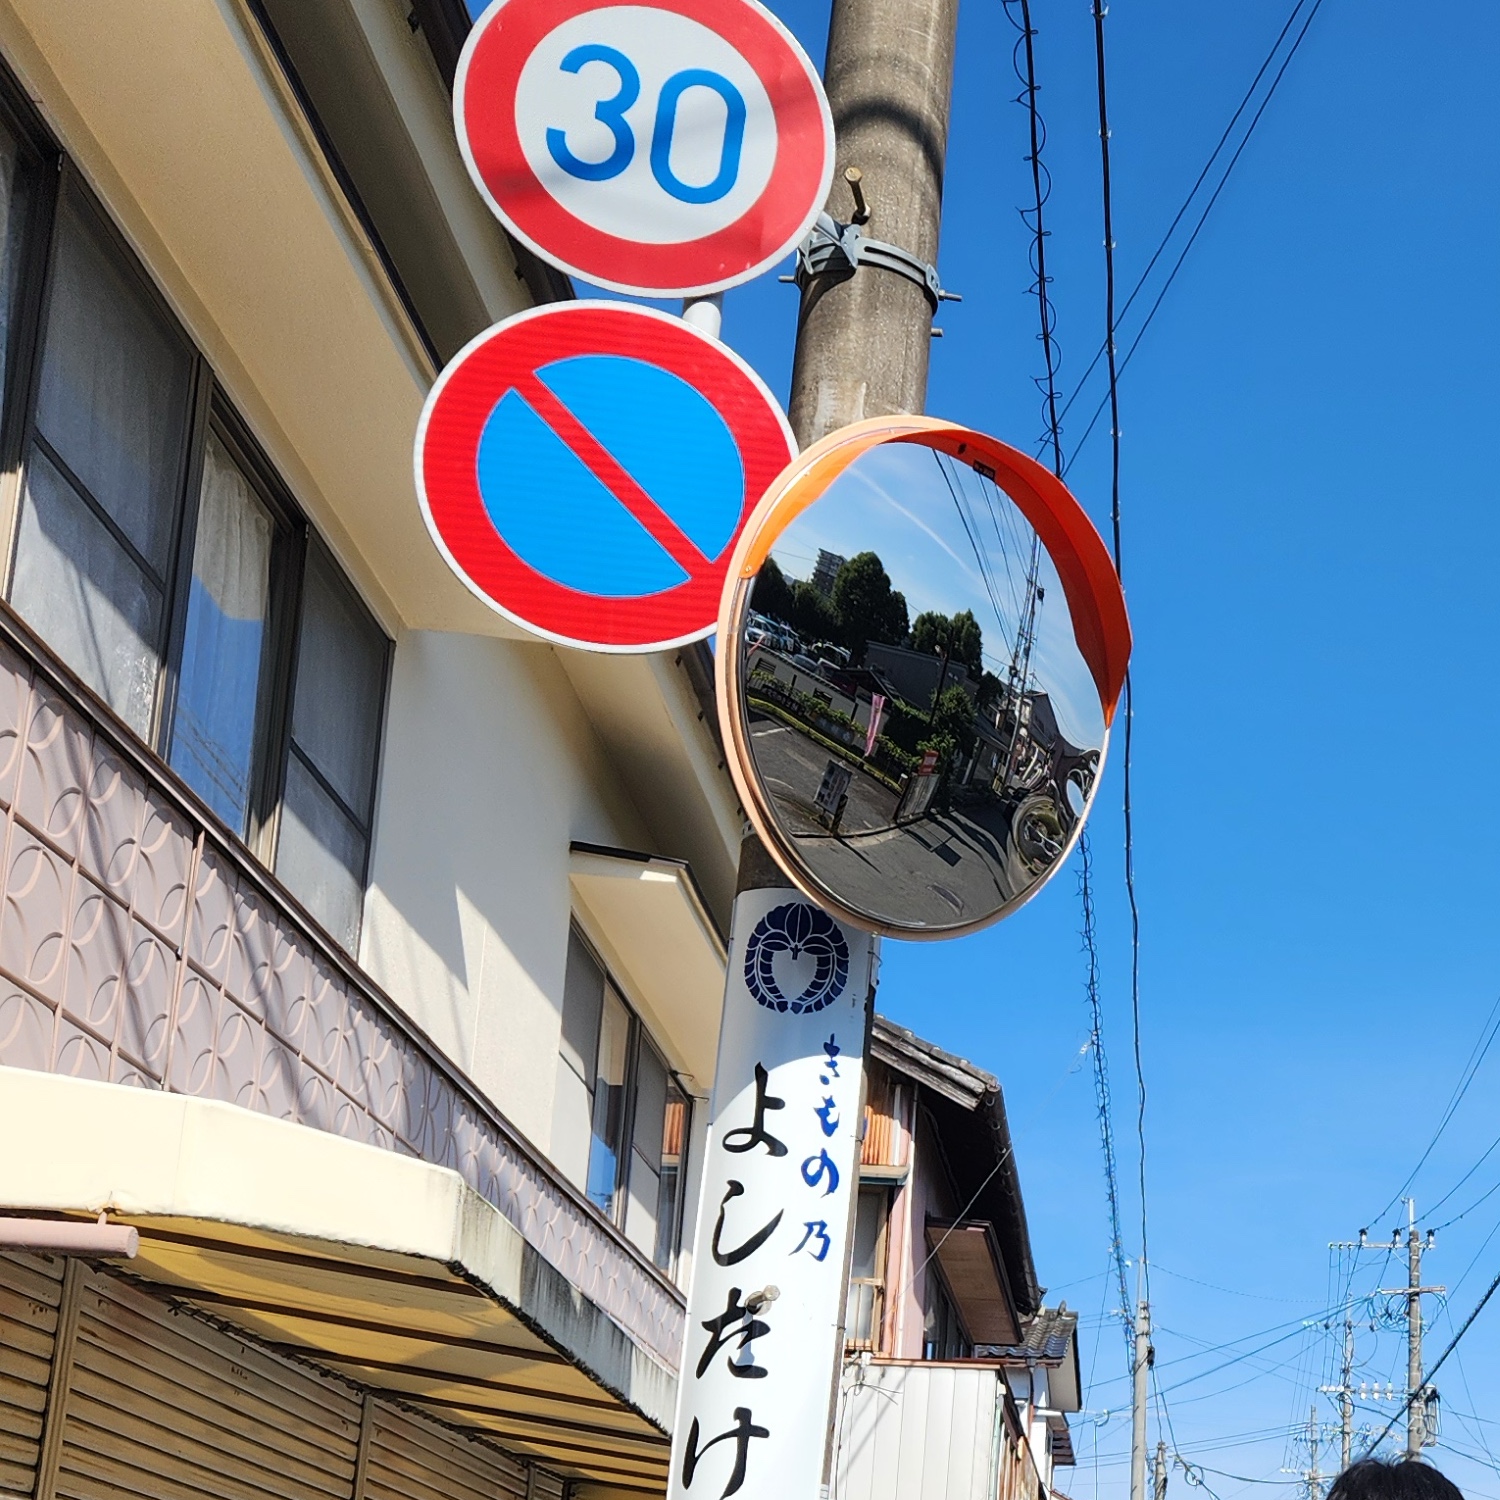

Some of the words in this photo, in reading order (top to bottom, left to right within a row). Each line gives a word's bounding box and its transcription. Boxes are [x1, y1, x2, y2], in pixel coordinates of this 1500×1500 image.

[547, 44, 746, 205] 30
[789, 1033, 841, 1262] きもの乃
